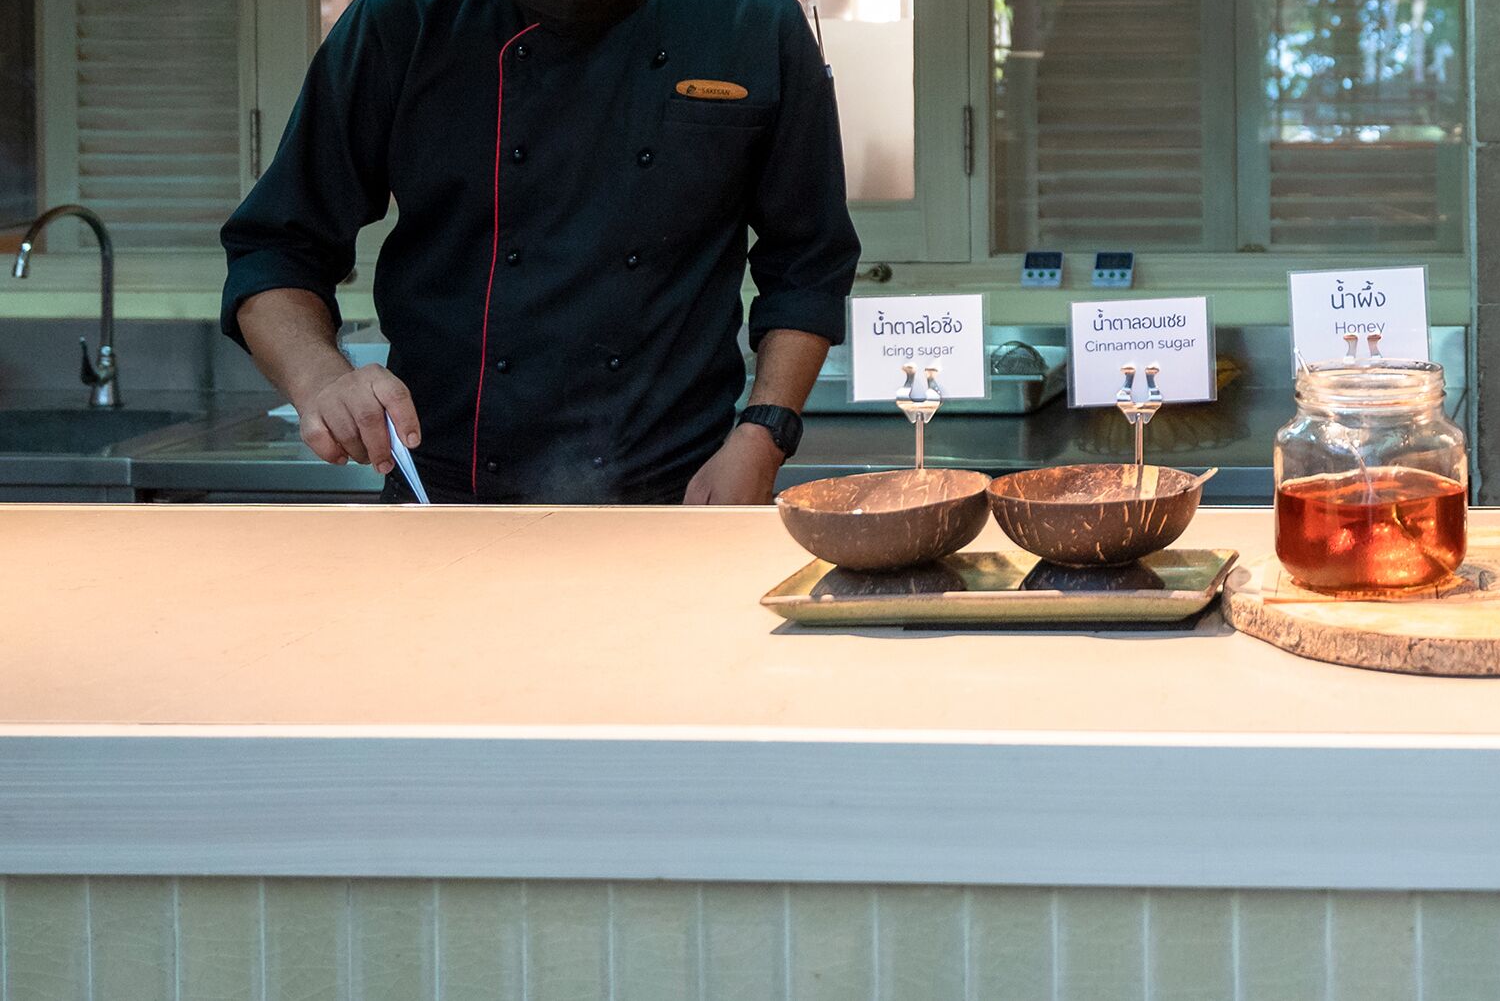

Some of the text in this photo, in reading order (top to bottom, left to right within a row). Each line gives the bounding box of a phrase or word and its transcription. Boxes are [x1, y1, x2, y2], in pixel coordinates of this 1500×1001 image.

[1330, 279, 1387, 310] น้ำผึ้ง
[1093, 309, 1187, 332] น้ำตาลอบเชย
[1335, 321, 1385, 335] Honey
[883, 345, 954, 359] Icing sugar
[1085, 337, 1196, 352] Cinnamon sugar
